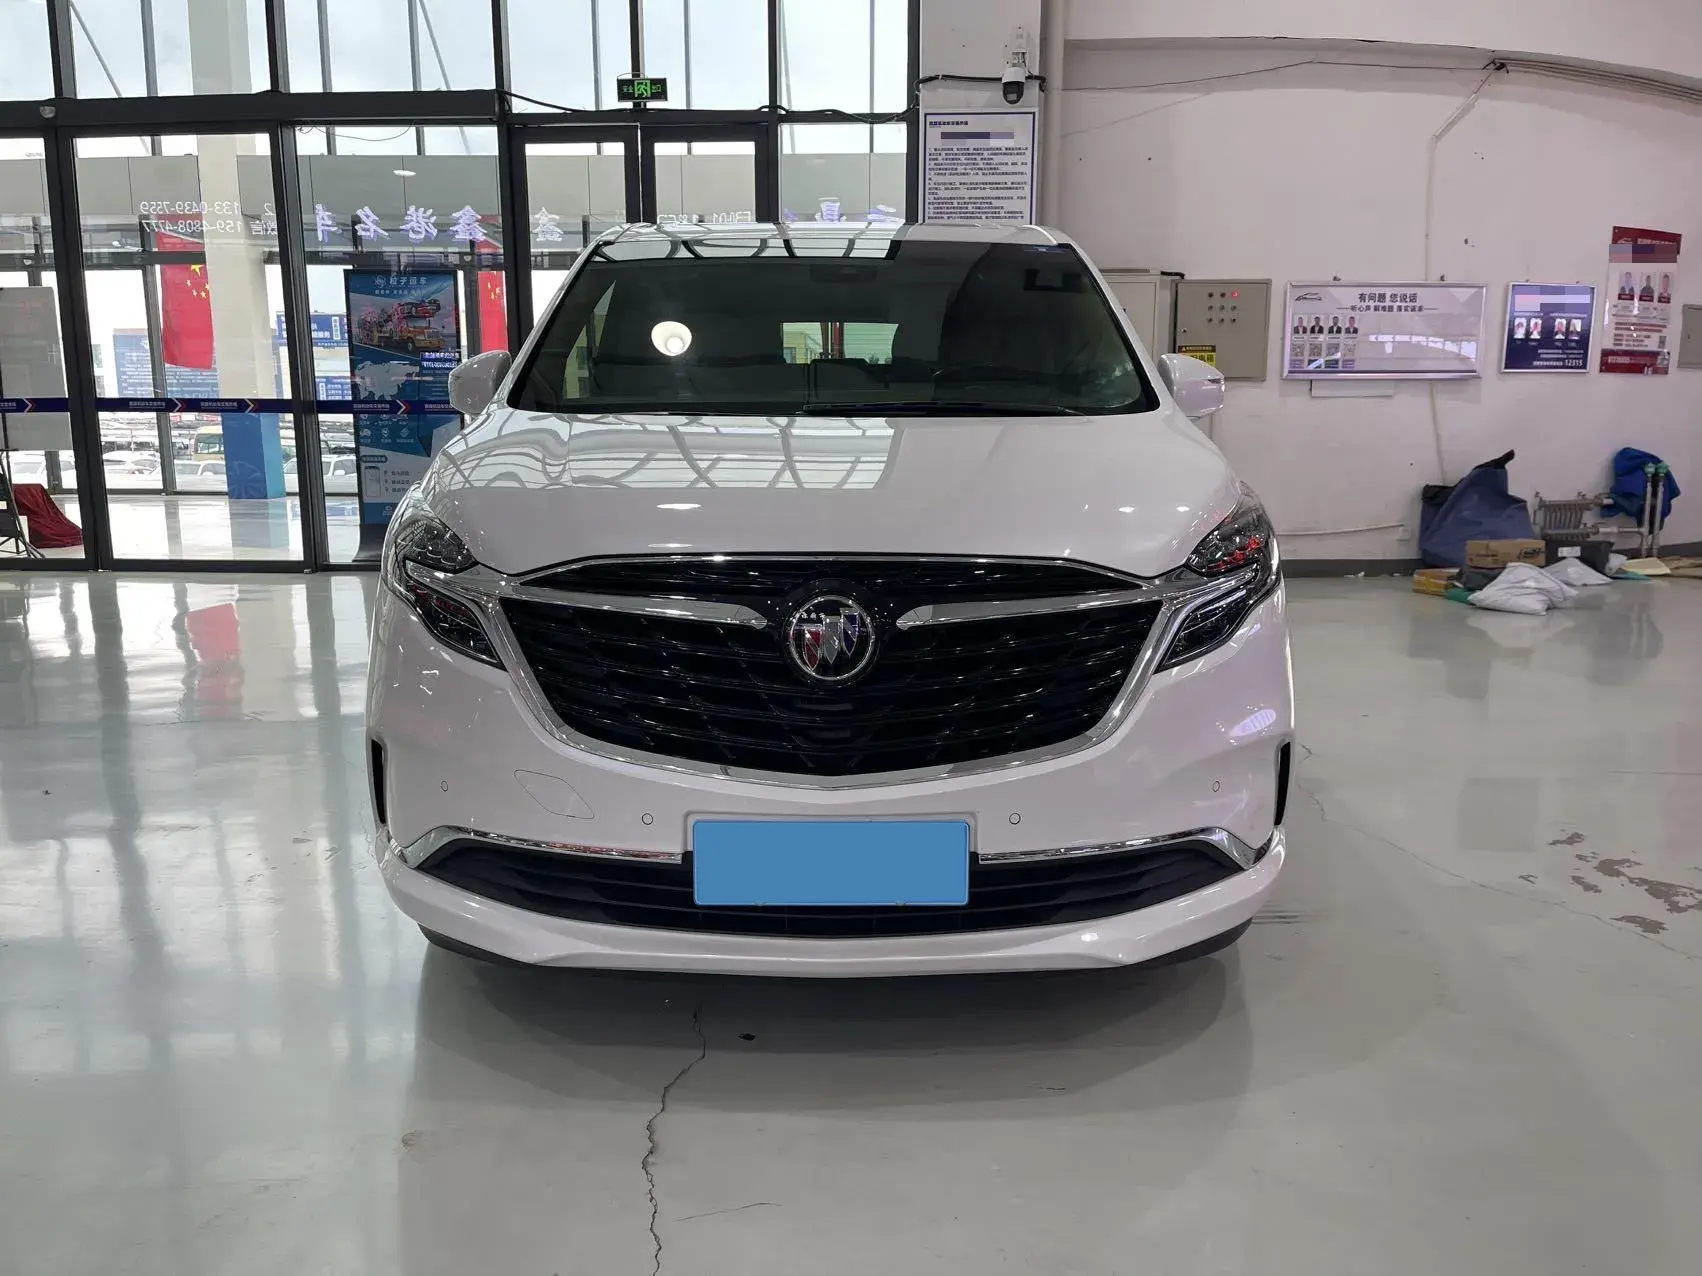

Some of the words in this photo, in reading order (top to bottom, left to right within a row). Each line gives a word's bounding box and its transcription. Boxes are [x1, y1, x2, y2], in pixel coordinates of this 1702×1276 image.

[622, 84, 634, 93] 安全
[651, 84, 662, 93] 出口
[1358, 292, 1387, 304] 有问题
[1389, 292, 1418, 304] 您说话
